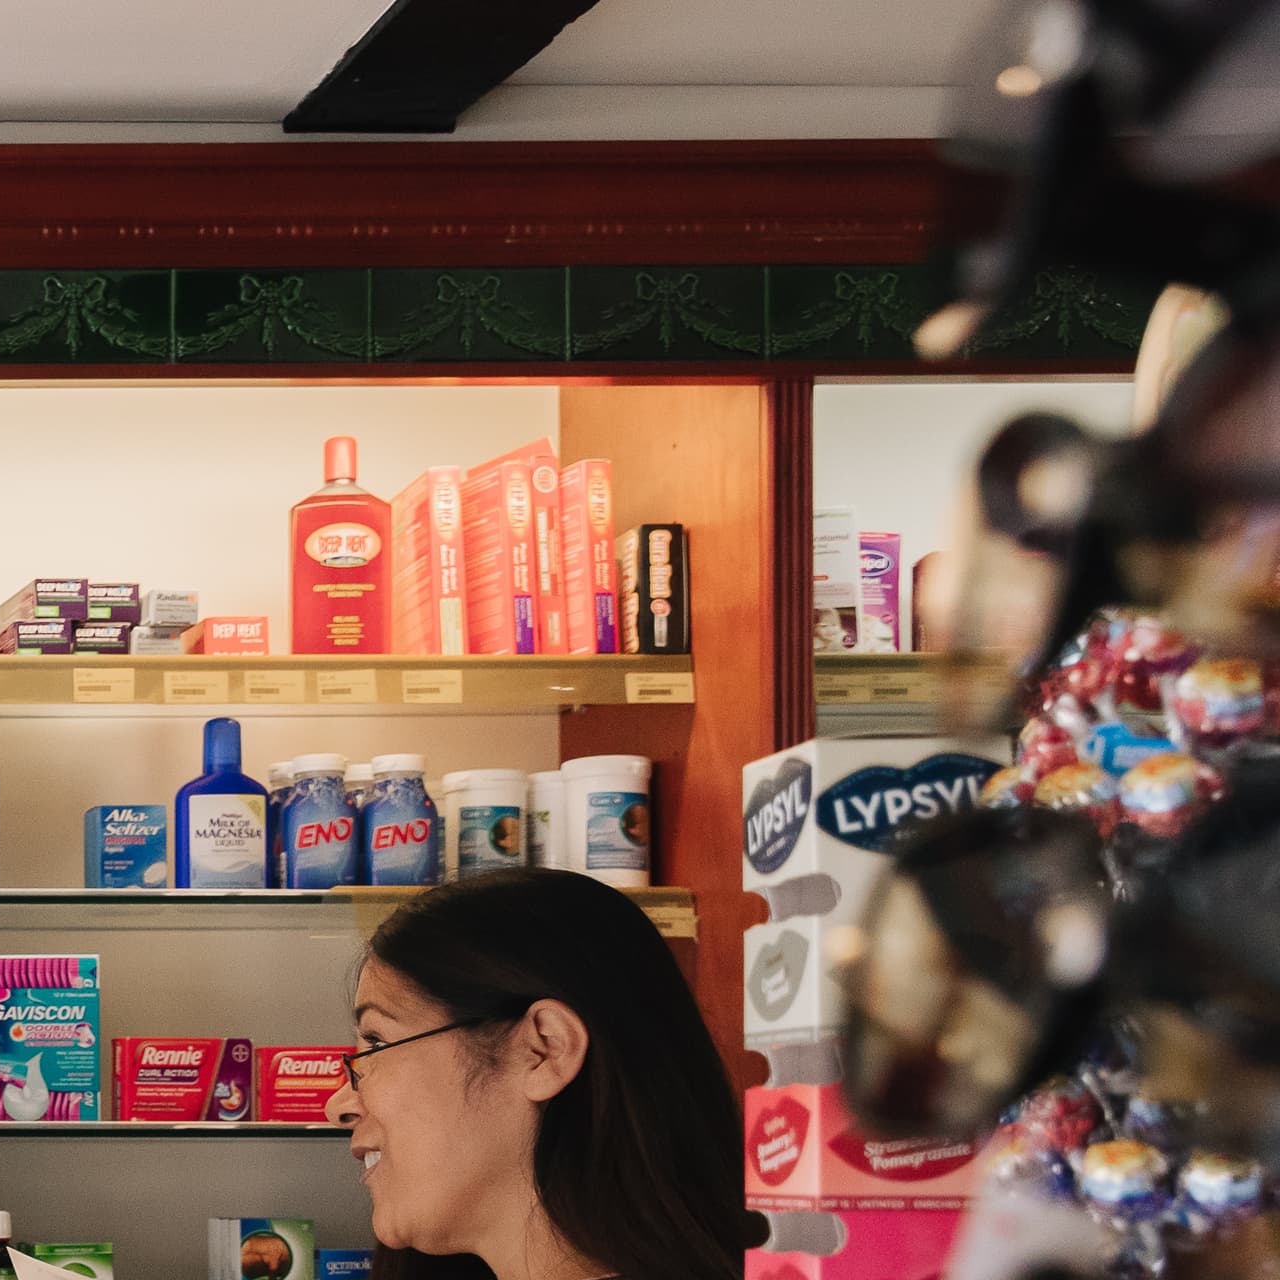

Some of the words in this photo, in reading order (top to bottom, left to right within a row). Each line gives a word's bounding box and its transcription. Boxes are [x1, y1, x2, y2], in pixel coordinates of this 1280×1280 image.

[104, 808, 147, 822] Alka-
[747, 777, 806, 857] LYPSYL
[103, 823, 161, 836] Seltzer
[194, 827, 262, 840] MAGNESIA
[297, 818, 354, 848] ENO
[373, 818, 431, 850] ENO
[24, 1024, 75, 1033] DOUBLE
[142, 1045, 203, 1065] Rennie
[278, 1056, 341, 1075] Rennie
